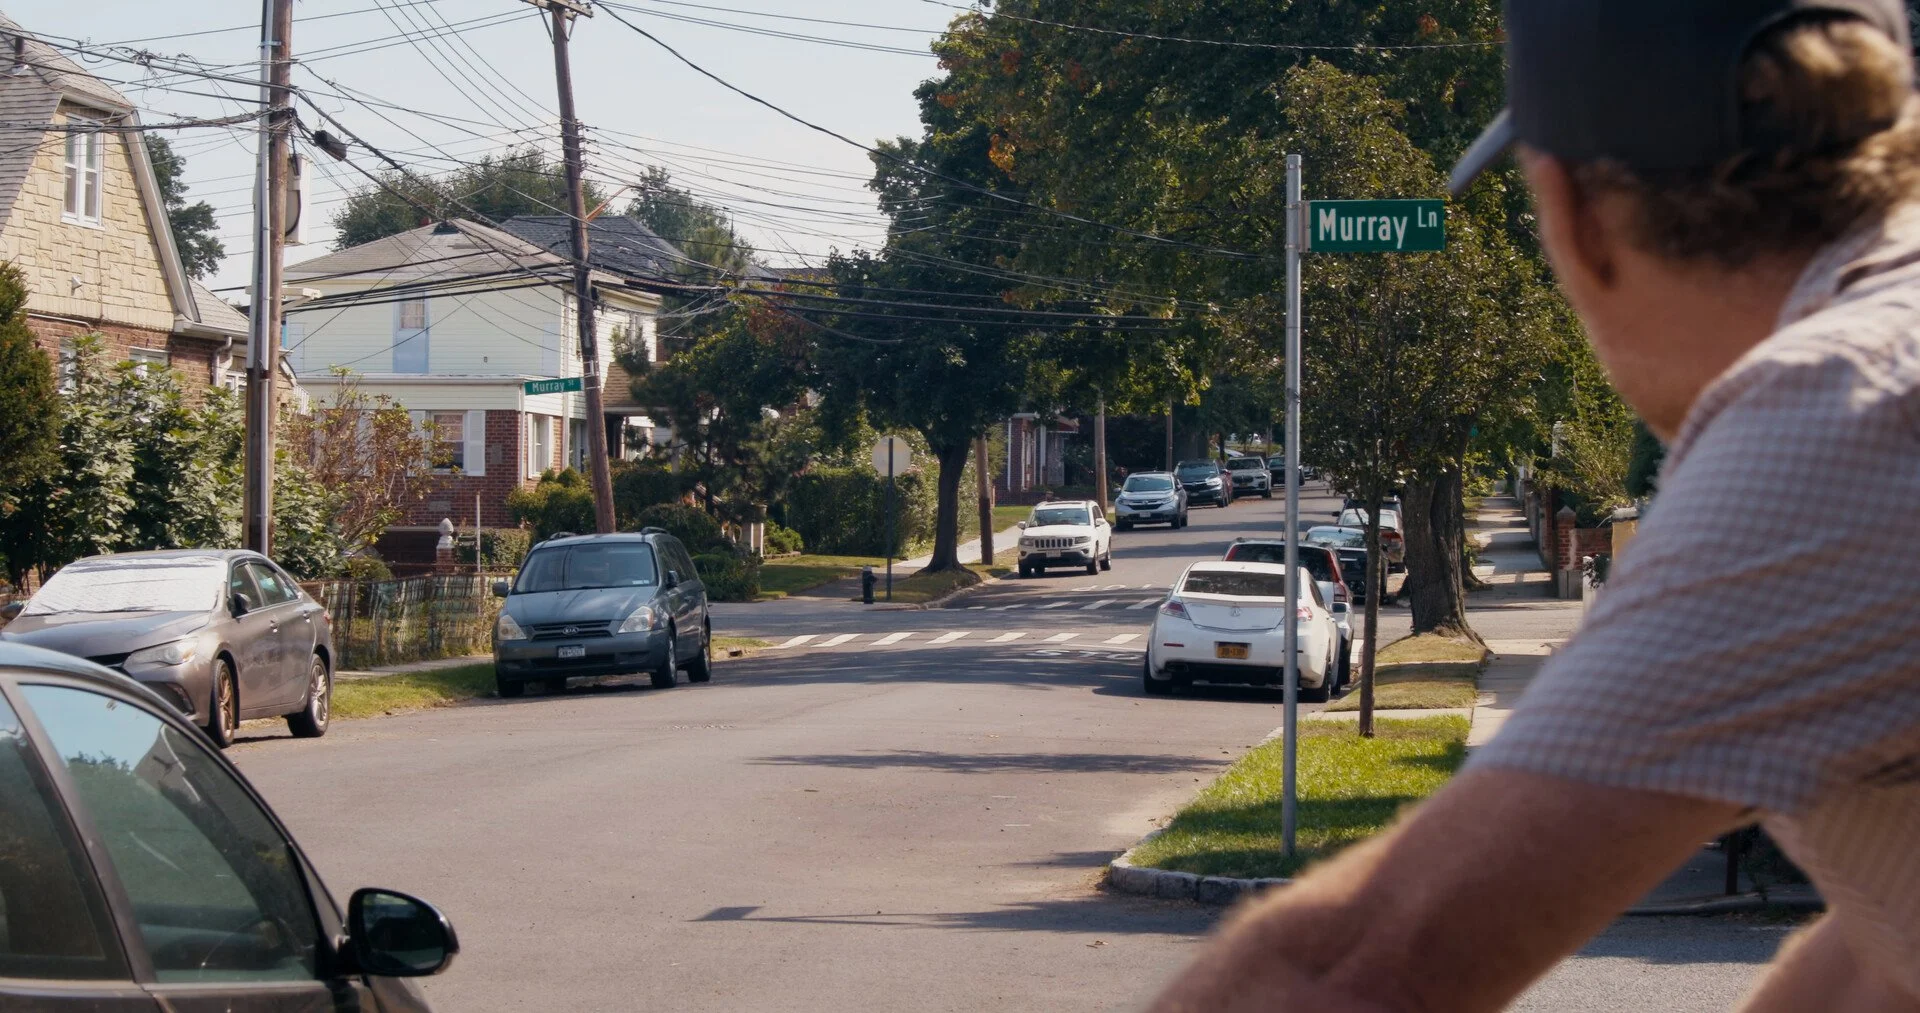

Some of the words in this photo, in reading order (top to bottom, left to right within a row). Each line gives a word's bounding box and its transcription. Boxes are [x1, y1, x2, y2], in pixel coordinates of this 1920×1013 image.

[1319, 207, 1408, 249] Murray
[1418, 206, 1438, 228] Ln
[532, 382, 565, 392] Murray
